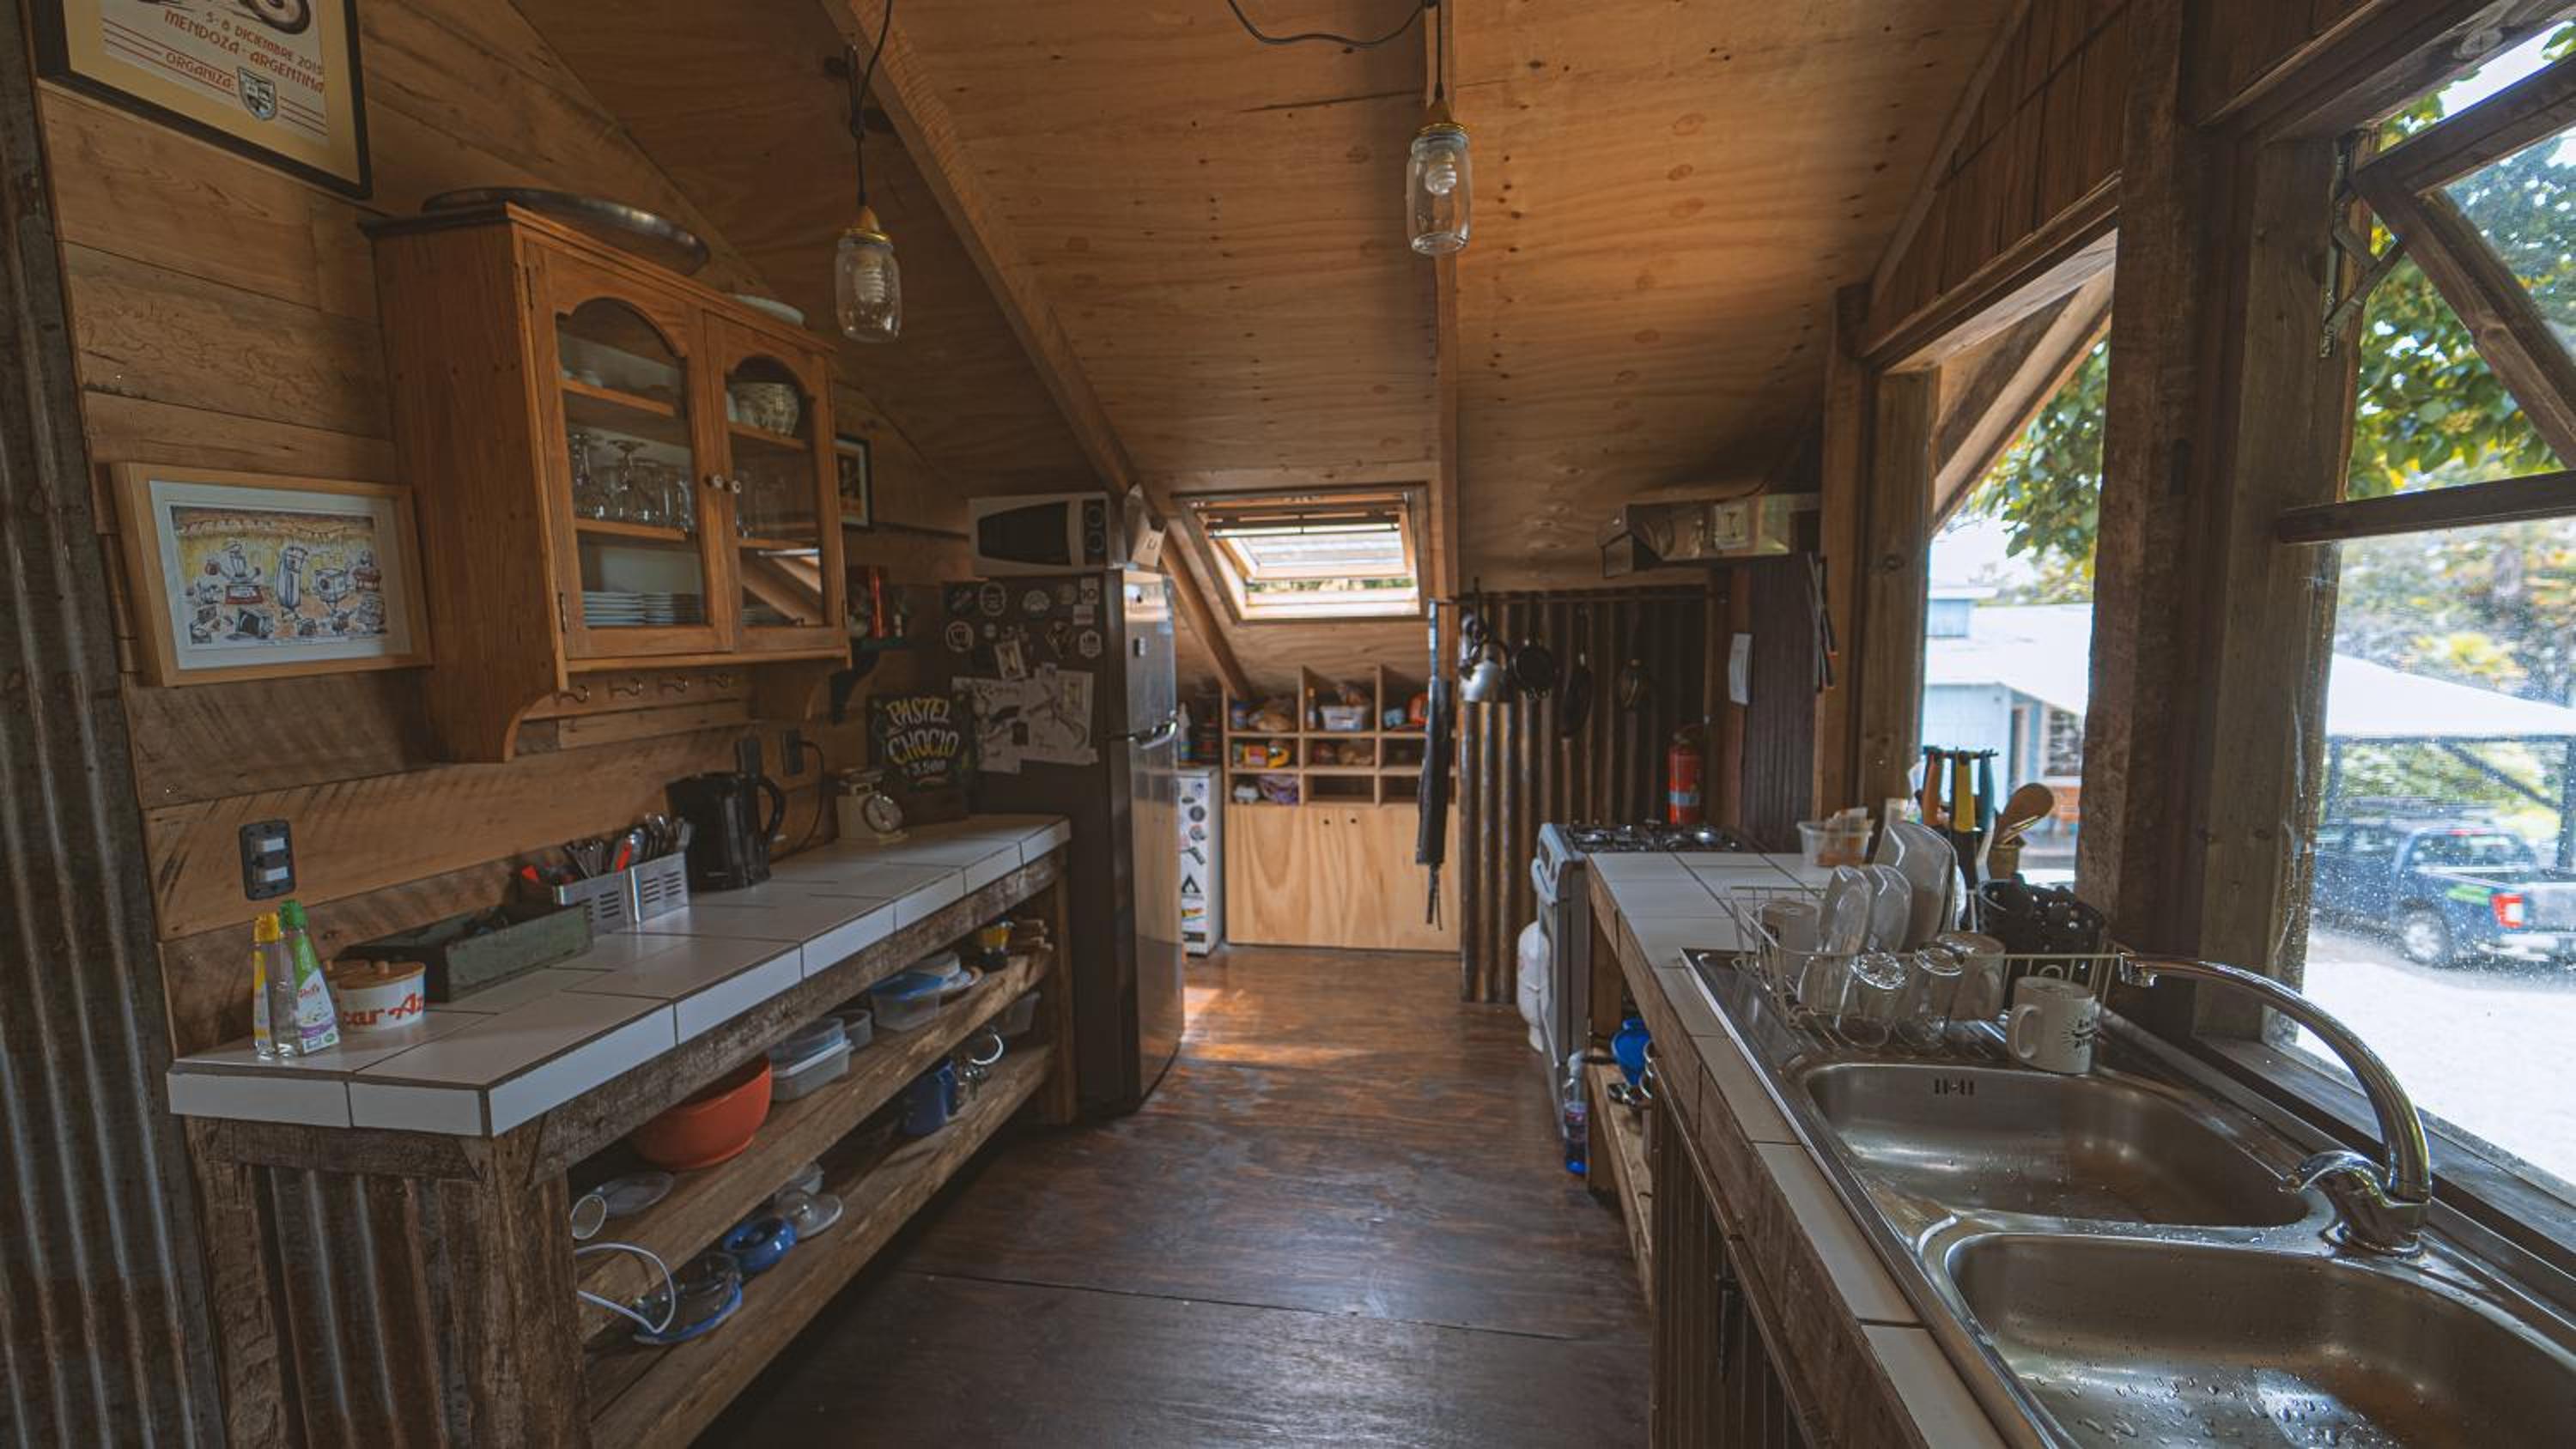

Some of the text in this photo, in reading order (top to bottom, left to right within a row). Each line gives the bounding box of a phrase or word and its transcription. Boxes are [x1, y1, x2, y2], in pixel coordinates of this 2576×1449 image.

[164, 9, 240, 55] MENDOZA
[250, 52, 324, 94] ARGENTINA
[235, 25, 294, 60] DICIEMBRE
[885, 696, 951, 729] PASTEL
